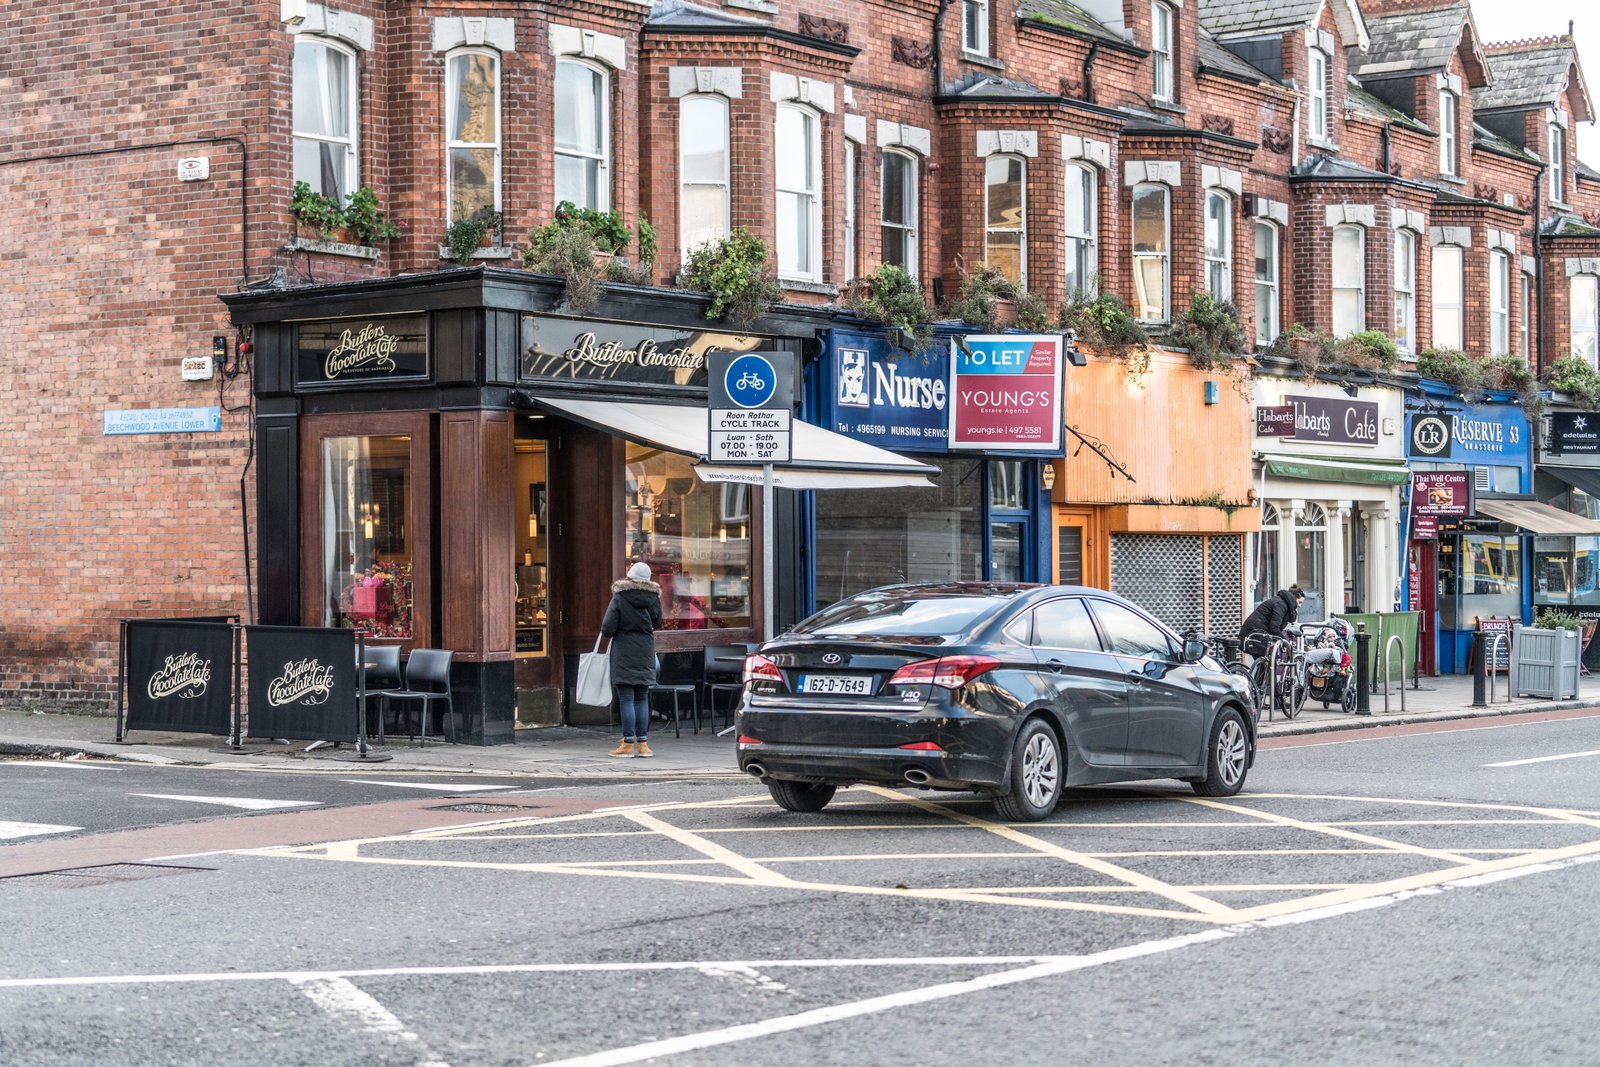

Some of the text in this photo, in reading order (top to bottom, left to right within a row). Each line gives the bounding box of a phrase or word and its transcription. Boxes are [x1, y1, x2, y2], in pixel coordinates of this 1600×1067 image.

[335, 323, 385, 356] Butlers
[325, 335, 399, 379] Chocolate Café
[564, 332, 637, 367] Butlers
[636, 338, 704, 369] Chocolate
[992, 350, 1024, 365] LET
[872, 362, 946, 410] Nurse
[961, 390, 1049, 407] YOUNG'S
[726, 411, 774, 419] Raon Rothar
[1257, 409, 1294, 422] Hobarts
[107, 420, 205, 432] BEECHWOOD AVENUE LOWER
[720, 420, 780, 428] CYCLE TRACK
[838, 422, 849, 432] Tel
[856, 424, 886, 435] 4965199
[890, 426, 921, 437] NURSING
[967, 426, 1004, 435] youngs.ie
[1008, 426, 1023, 434] 497
[1344, 407, 1376, 440] Café
[1452, 415, 1503, 444] RÉSERVE
[726, 433, 745, 441] Luan
[755, 433, 774, 441] Sath
[1420, 430, 1440, 444] LR
[727, 450, 748, 458] MON
[757, 450, 773, 458] SAT
[1464, 442, 1503, 452] BRASSERIE
[1415, 474, 1429, 482] Thai
[1430, 474, 1444, 482] Well
[1444, 474, 1466, 482] Centre
[1483, 622, 1506, 630] BRUNCH
[163, 651, 198, 676] Butlers
[281, 657, 318, 684] Butlers
[148, 667, 192, 699] Chocolate
[268, 672, 313, 706] Chocolate
[808, 678, 865, 693] 162-D-7649
